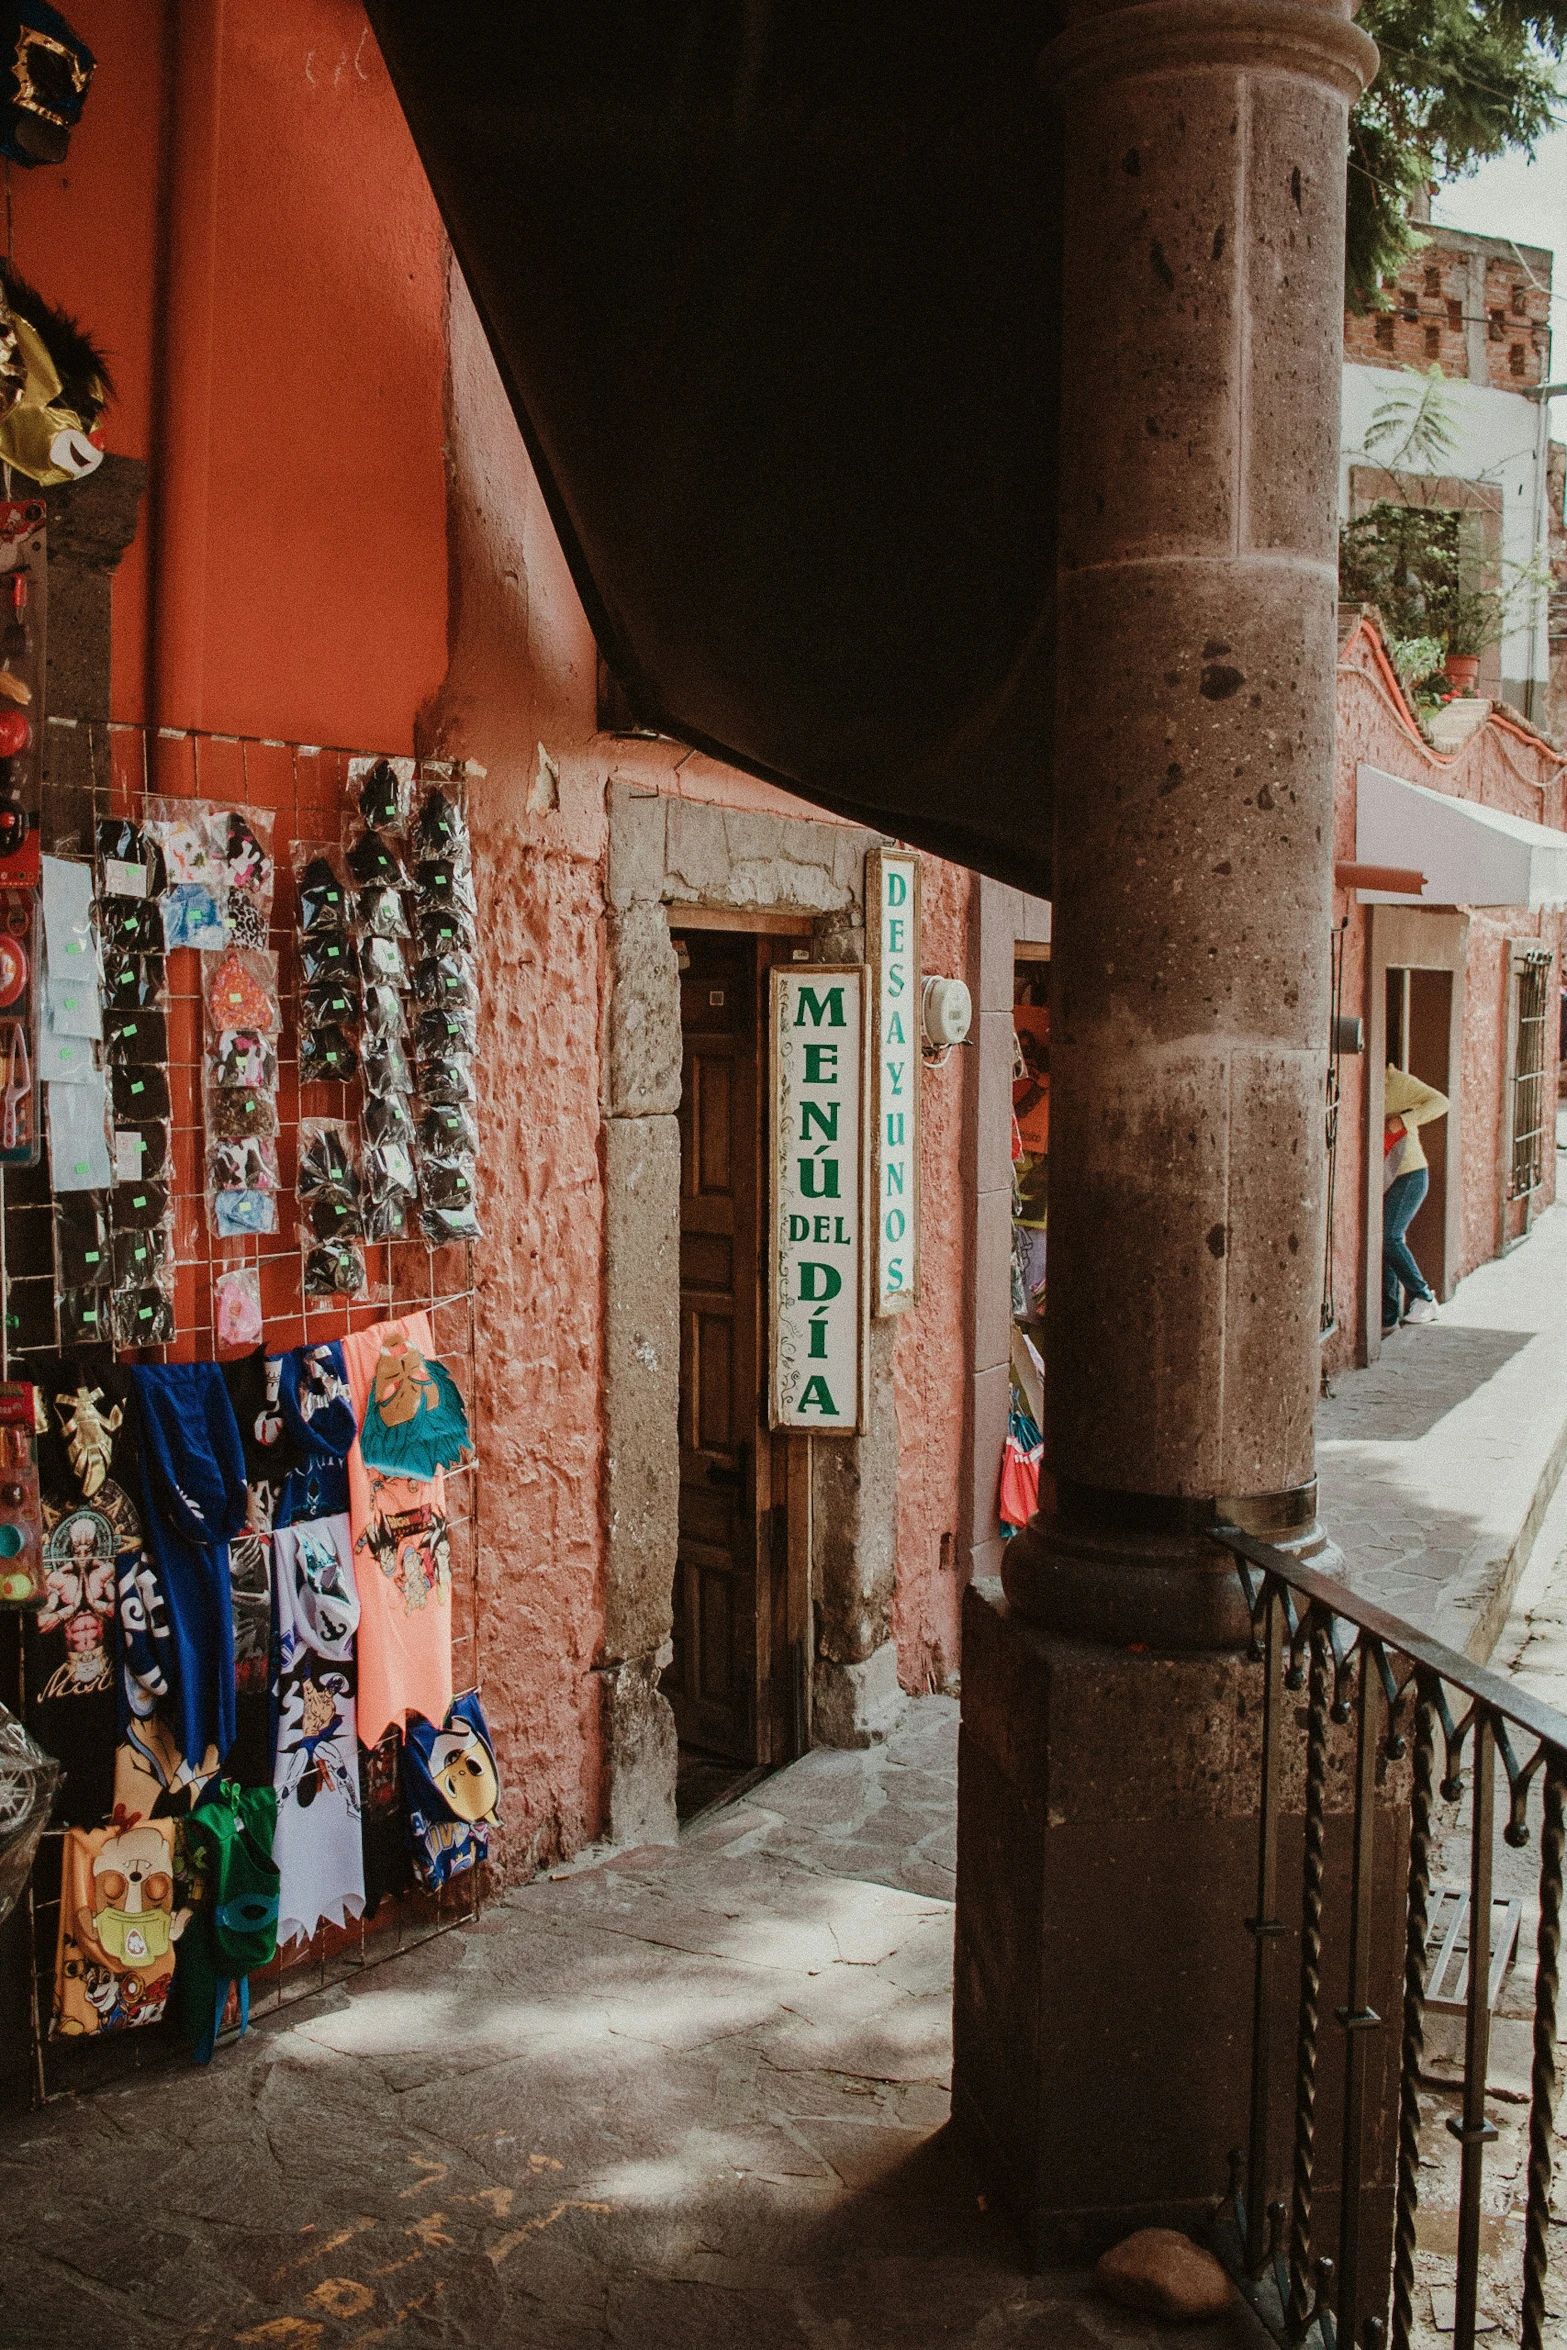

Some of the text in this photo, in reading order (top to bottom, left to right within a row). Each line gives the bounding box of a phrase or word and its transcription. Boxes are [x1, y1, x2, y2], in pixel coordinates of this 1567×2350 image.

[789, 986, 852, 1418] MENÚ DEL DÍA
[885, 872, 909, 1292] DESAYUNOS
